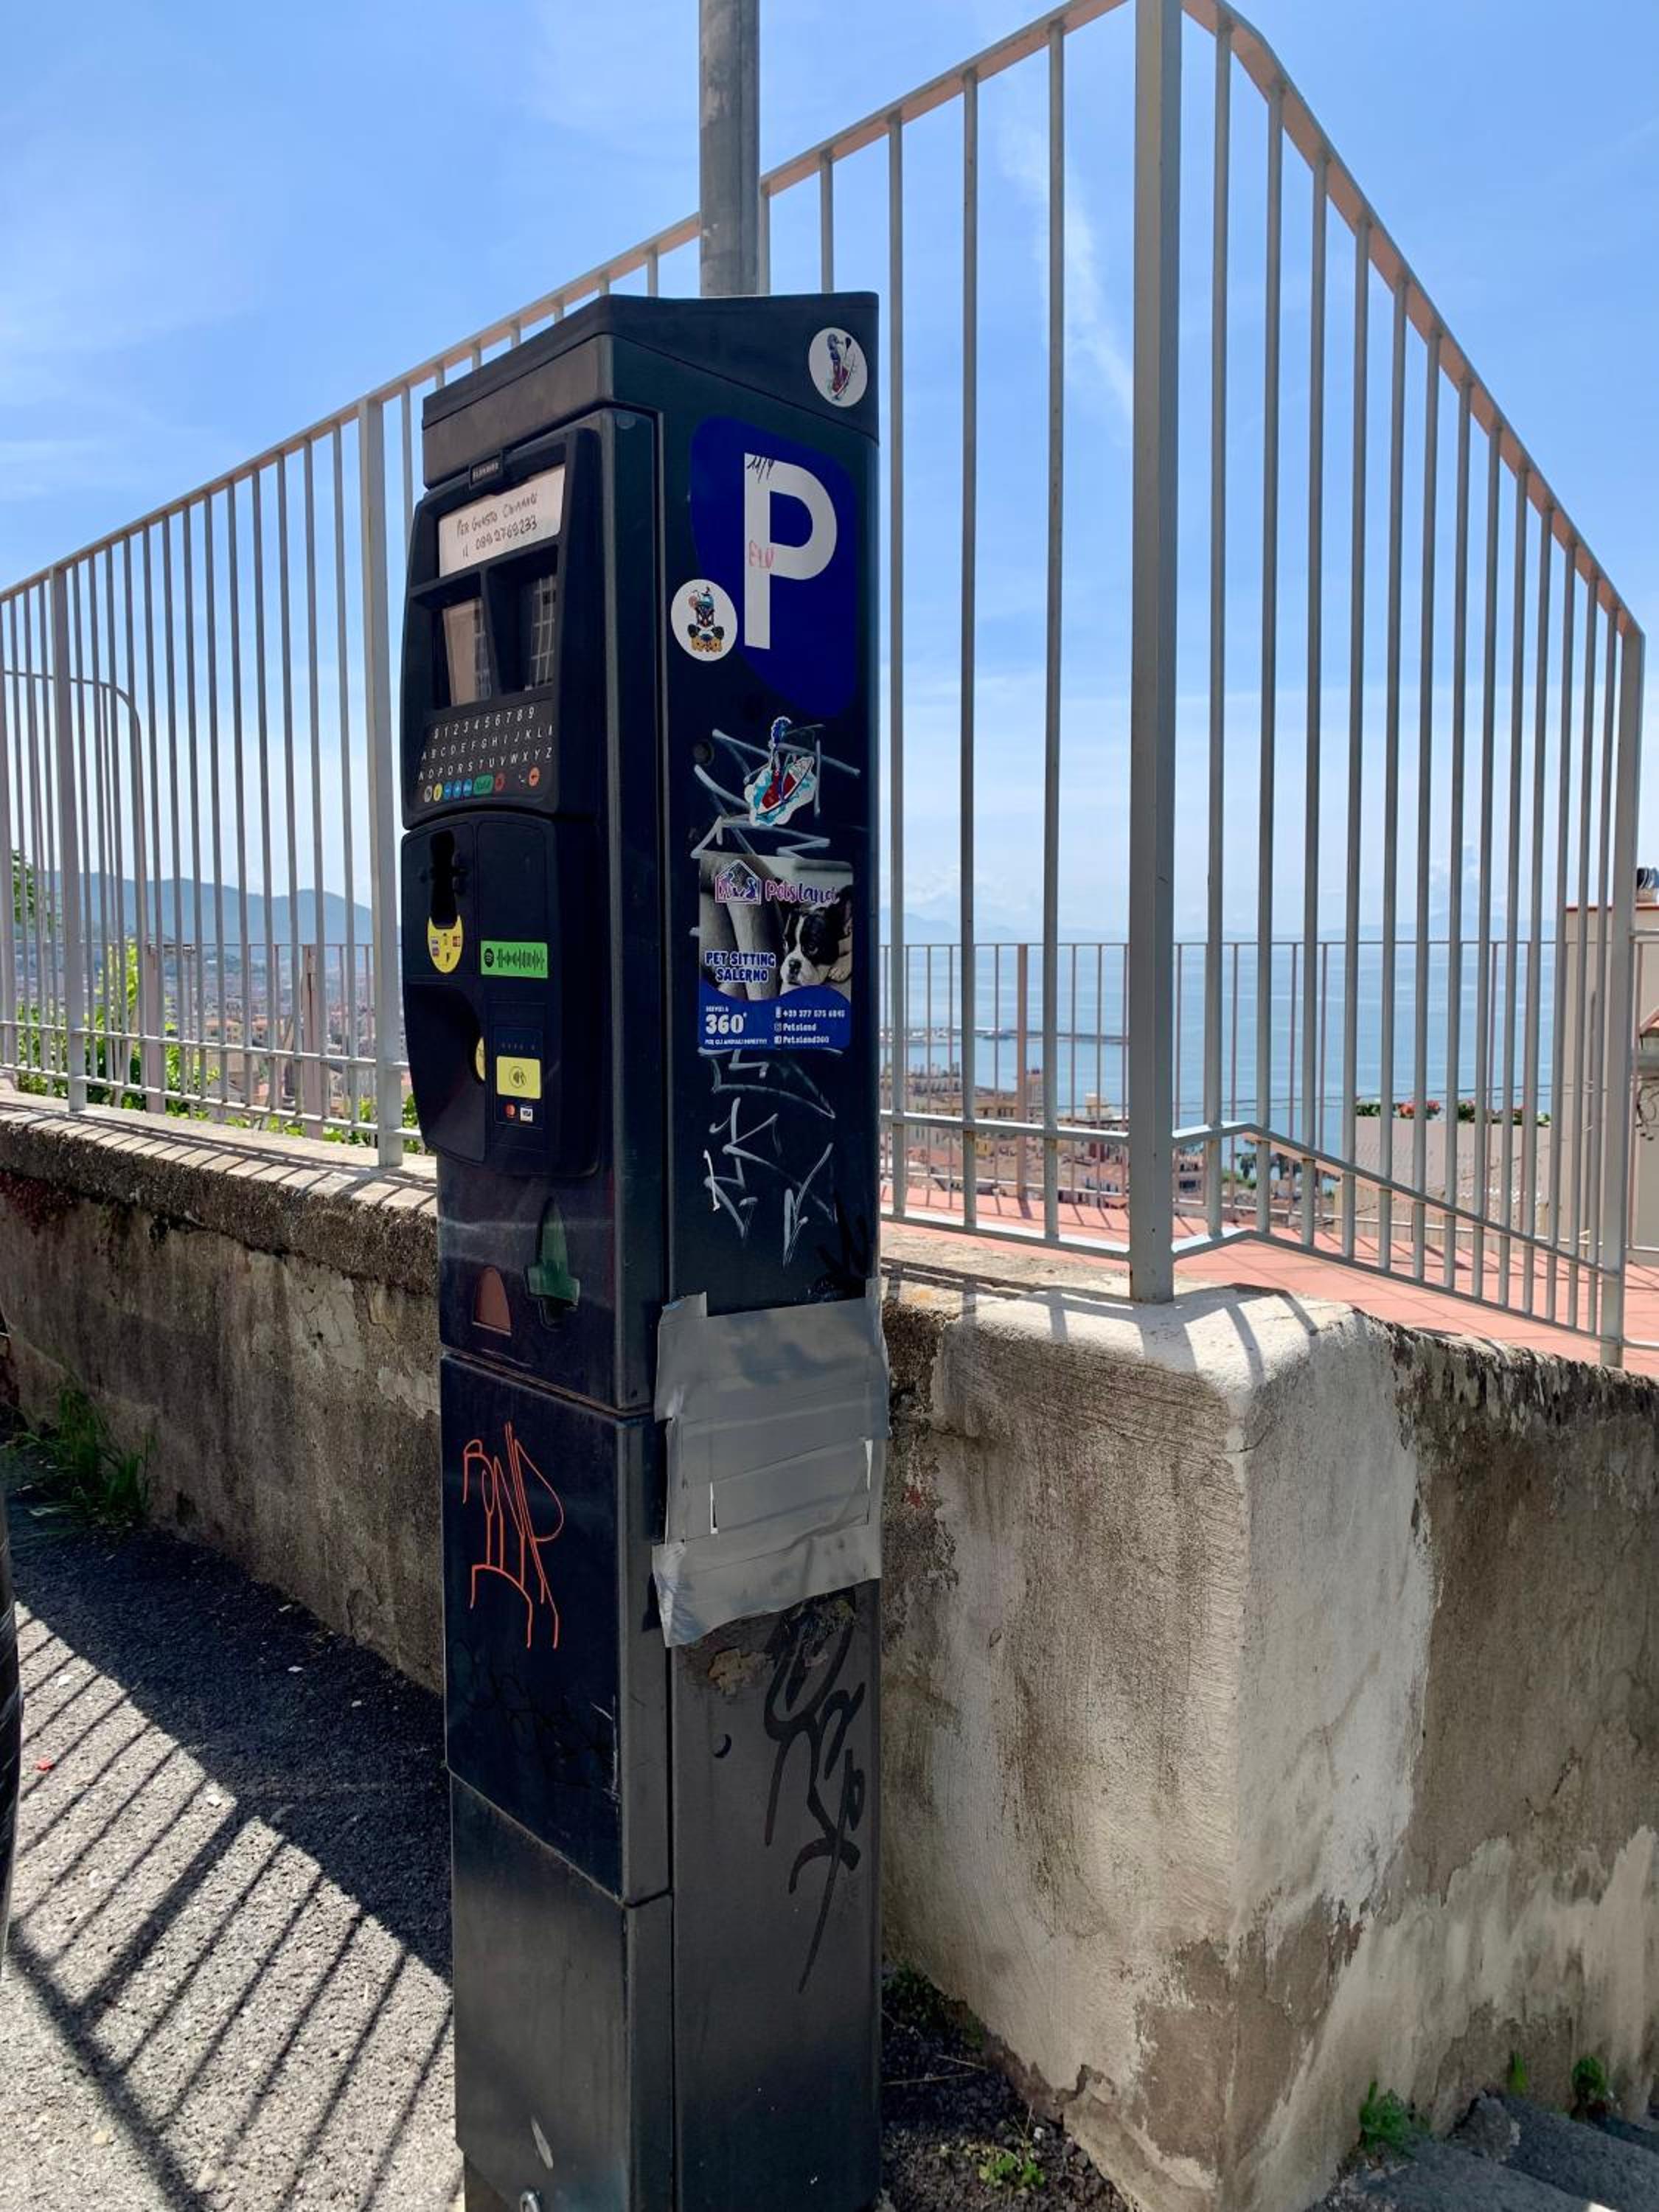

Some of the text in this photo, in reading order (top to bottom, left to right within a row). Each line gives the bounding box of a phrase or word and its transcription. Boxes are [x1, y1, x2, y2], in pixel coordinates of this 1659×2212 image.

[745, 452, 837, 650] P
[706, 951, 776, 967] PET SITTING
[717, 967, 768, 983] SALERNO
